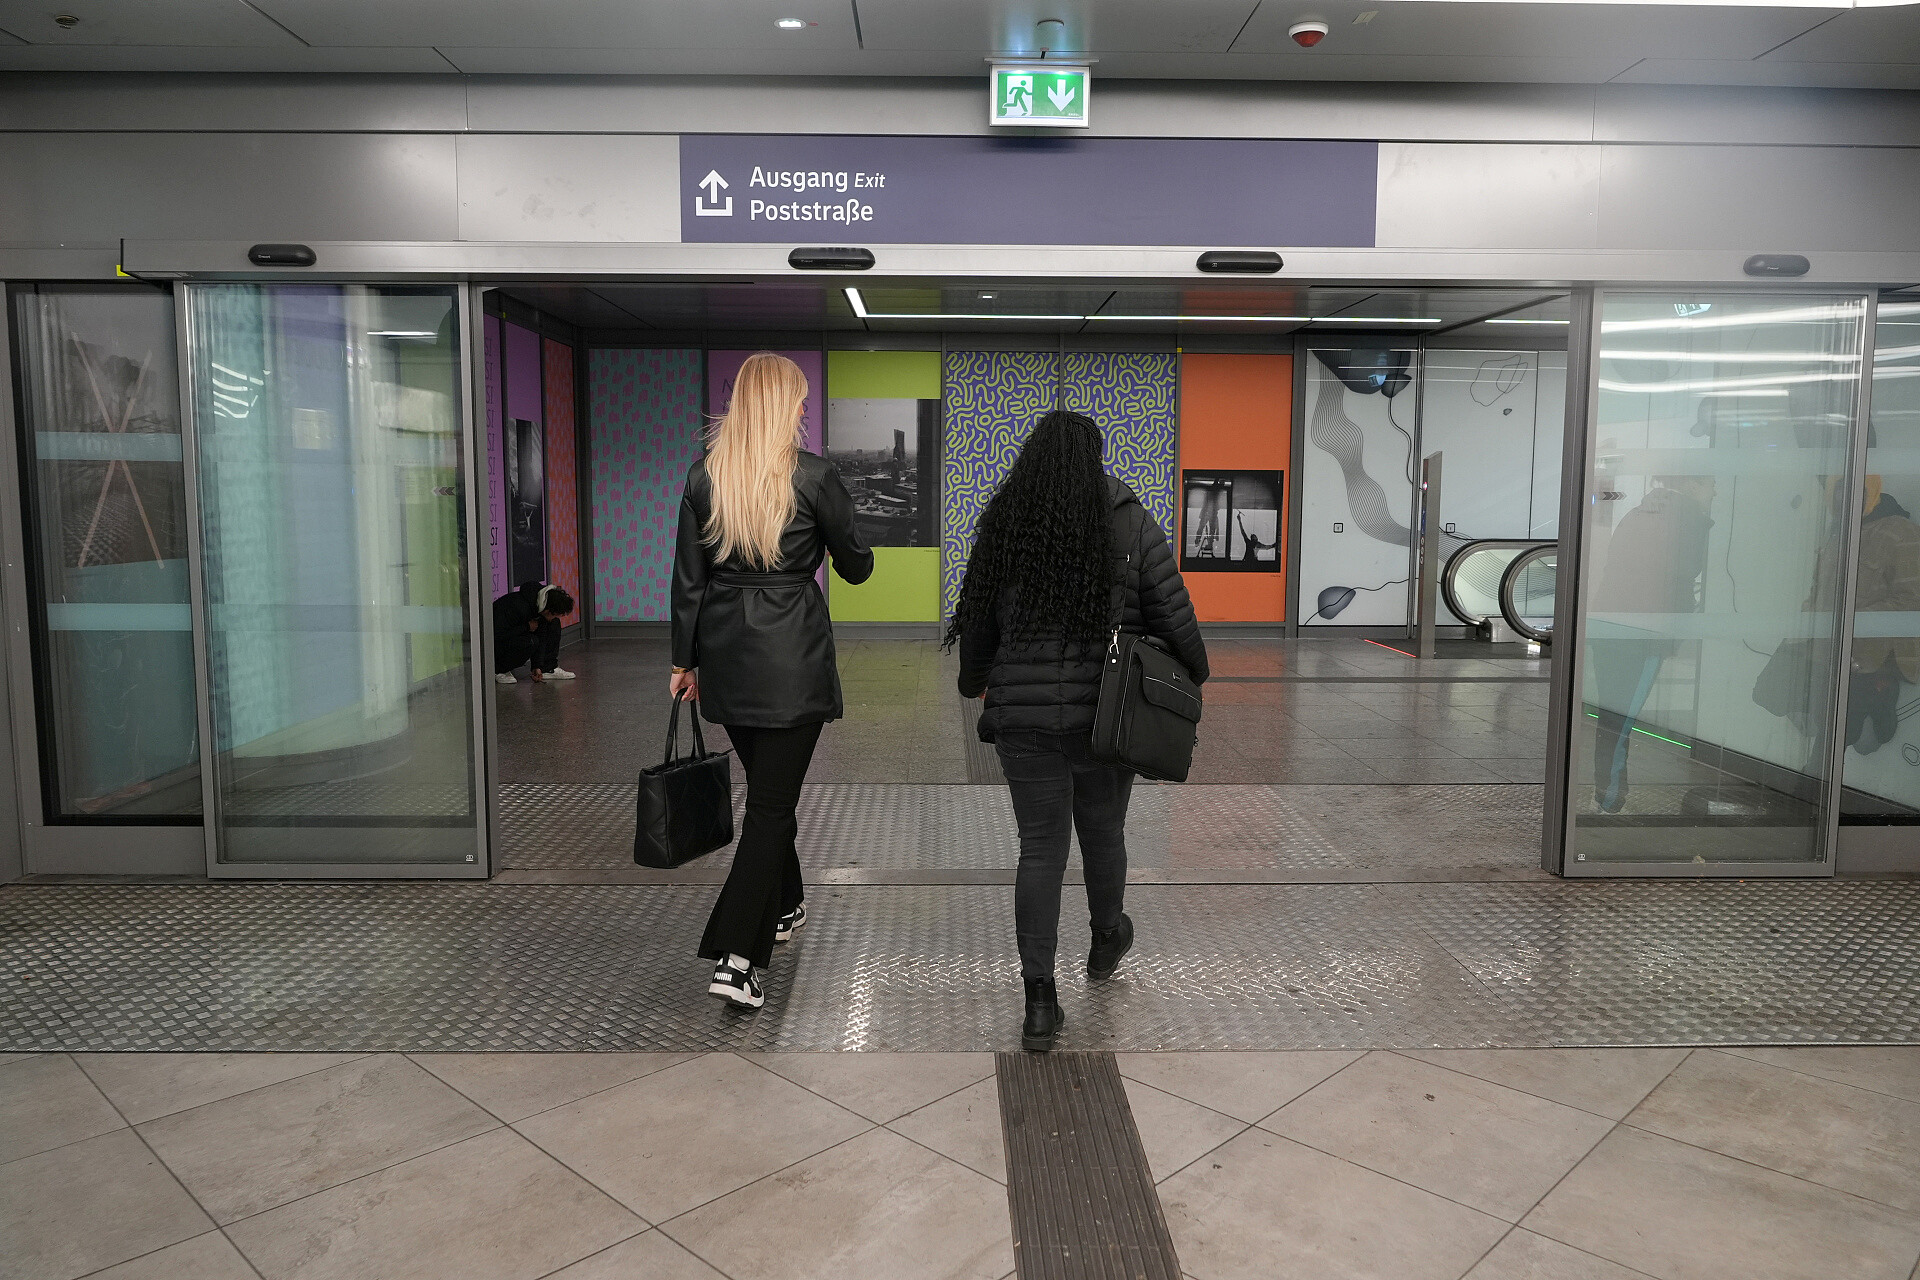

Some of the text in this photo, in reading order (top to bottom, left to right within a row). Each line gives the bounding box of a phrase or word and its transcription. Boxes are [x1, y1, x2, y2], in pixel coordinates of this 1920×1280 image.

[750, 166, 886, 192] Ausgang Exit
[750, 199, 873, 225] Poststraße
